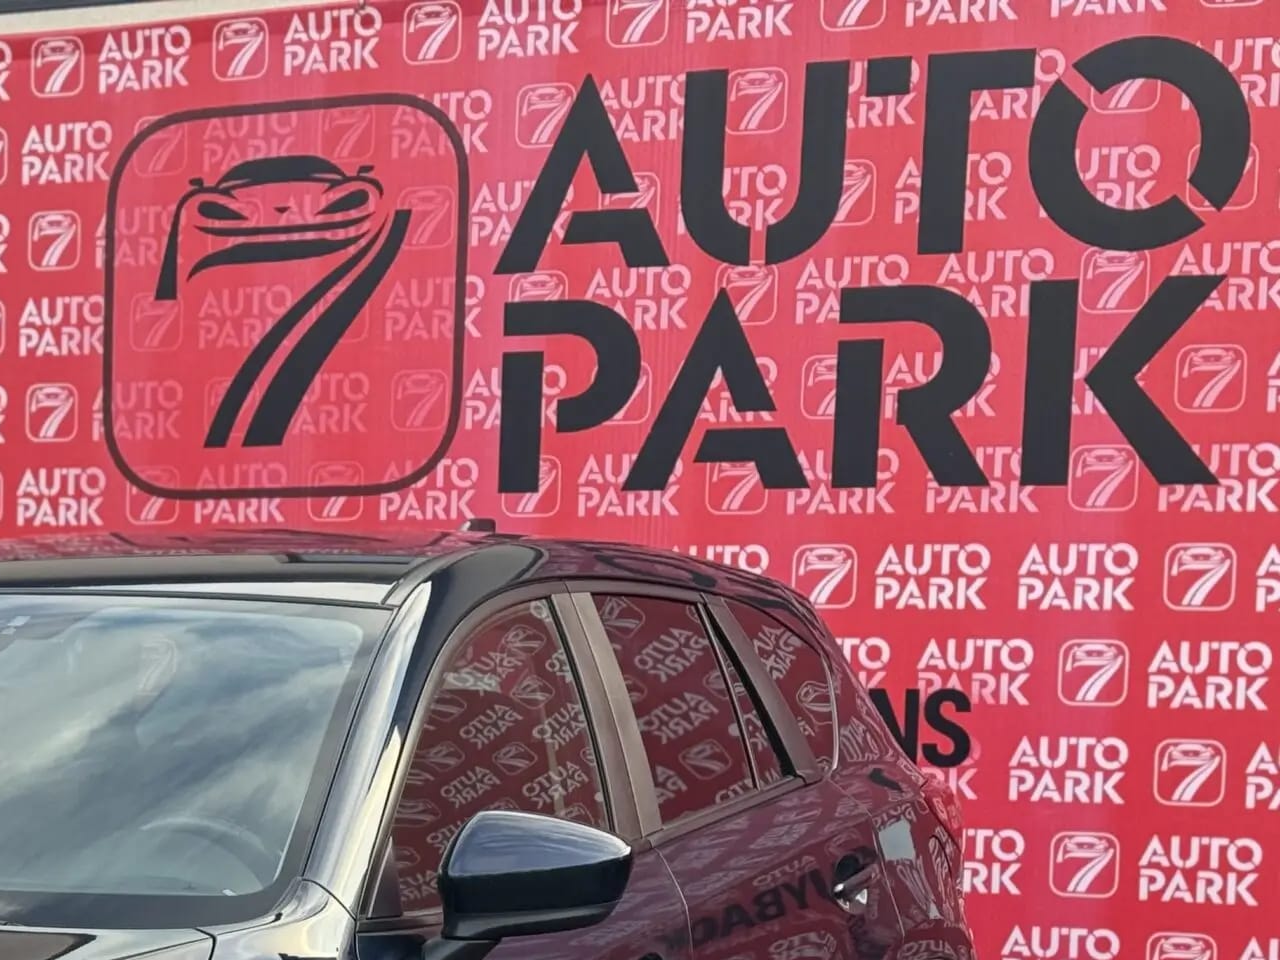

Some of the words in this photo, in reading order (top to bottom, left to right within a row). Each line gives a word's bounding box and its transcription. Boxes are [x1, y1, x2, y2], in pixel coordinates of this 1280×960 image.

[284, 6, 381, 43] AUTO
[478, 0, 581, 27] AUTO
[687, 4, 793, 43] PARK
[99, 26, 190, 62] AUTO
[285, 37, 379, 76] PARK
[478, 22, 578, 60] PARK
[99, 56, 188, 93] PARK
[22, 121, 112, 154] AUTO
[22, 152, 109, 185] PARK
[494, 36, 1252, 275] AUTO
[585, 264, 691, 300] AUTO
[796, 255, 909, 289] AUTO
[936, 248, 1054, 284] AUTO
[19, 296, 104, 326] AUTO
[20, 325, 103, 356] PARK
[498, 275, 1228, 494] PARK
[17, 468, 105, 498] AUTO
[787, 482, 896, 515] PARK
[927, 482, 1038, 512] PARK
[1159, 480, 1279, 512] PARK
[17, 497, 102, 526] PARK
[194, 497, 285, 524] PARK
[380, 489, 475, 520] PARK
[578, 484, 679, 517] PARK
[875, 544, 990, 576] AUTO
[1019, 543, 1138, 576] AUTO
[875, 577, 986, 609] PARK
[1018, 577, 1133, 610] PARK
[917, 638, 1034, 671] AUTO
[1148, 641, 1272, 675] AUTO
[1148, 675, 1268, 710] PARK
[1010, 737, 1128, 770] AUTO
[1009, 769, 1124, 804] PARK
[1139, 835, 1262, 871] AUTO
[1139, 869, 1258, 906] PARK
[1002, 926, 1120, 960] AUTO
